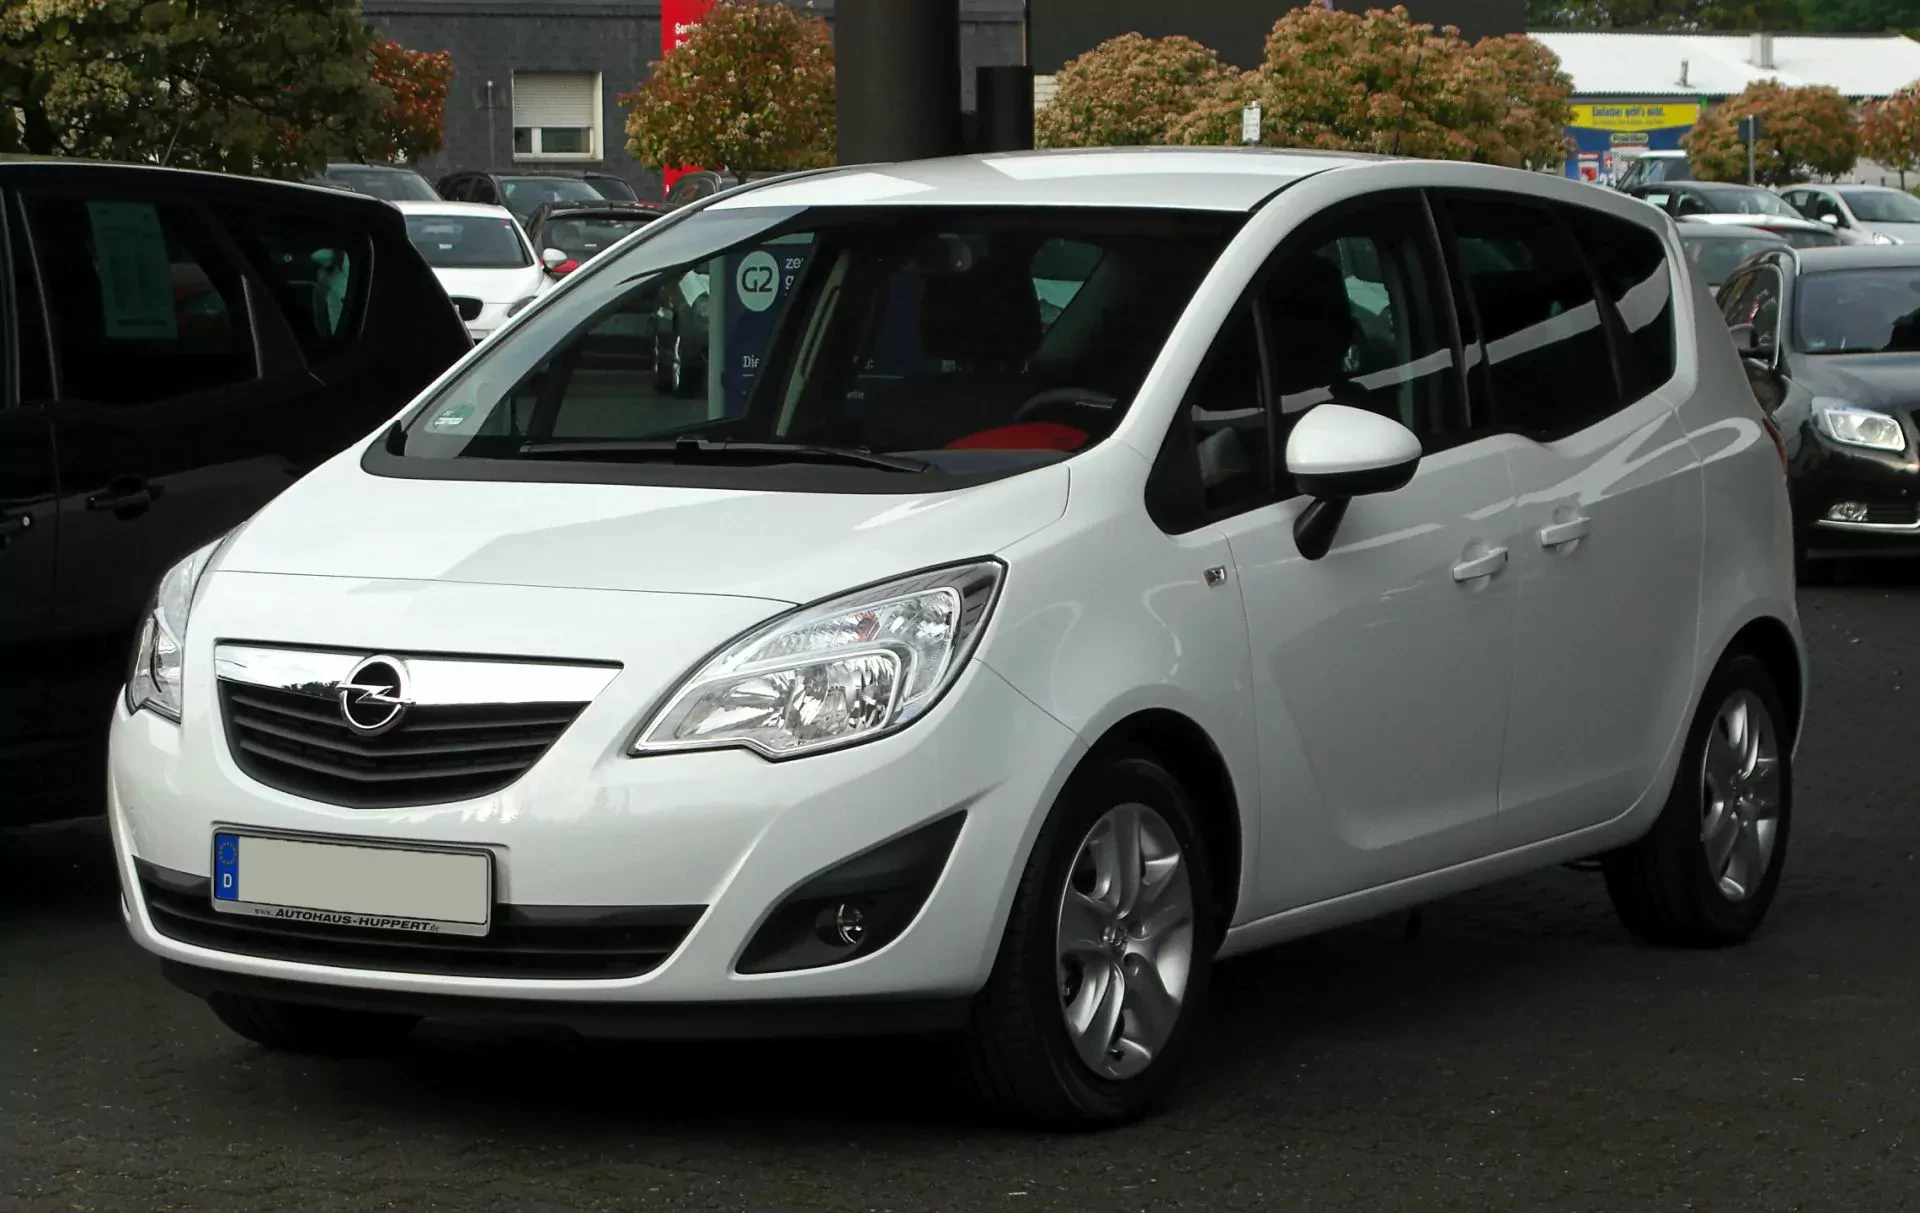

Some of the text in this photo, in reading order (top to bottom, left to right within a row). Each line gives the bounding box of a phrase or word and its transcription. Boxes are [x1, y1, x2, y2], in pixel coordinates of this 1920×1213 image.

[785, 258, 804, 269] ze
[741, 266, 774, 293] G2
[223, 873, 233, 888] D
